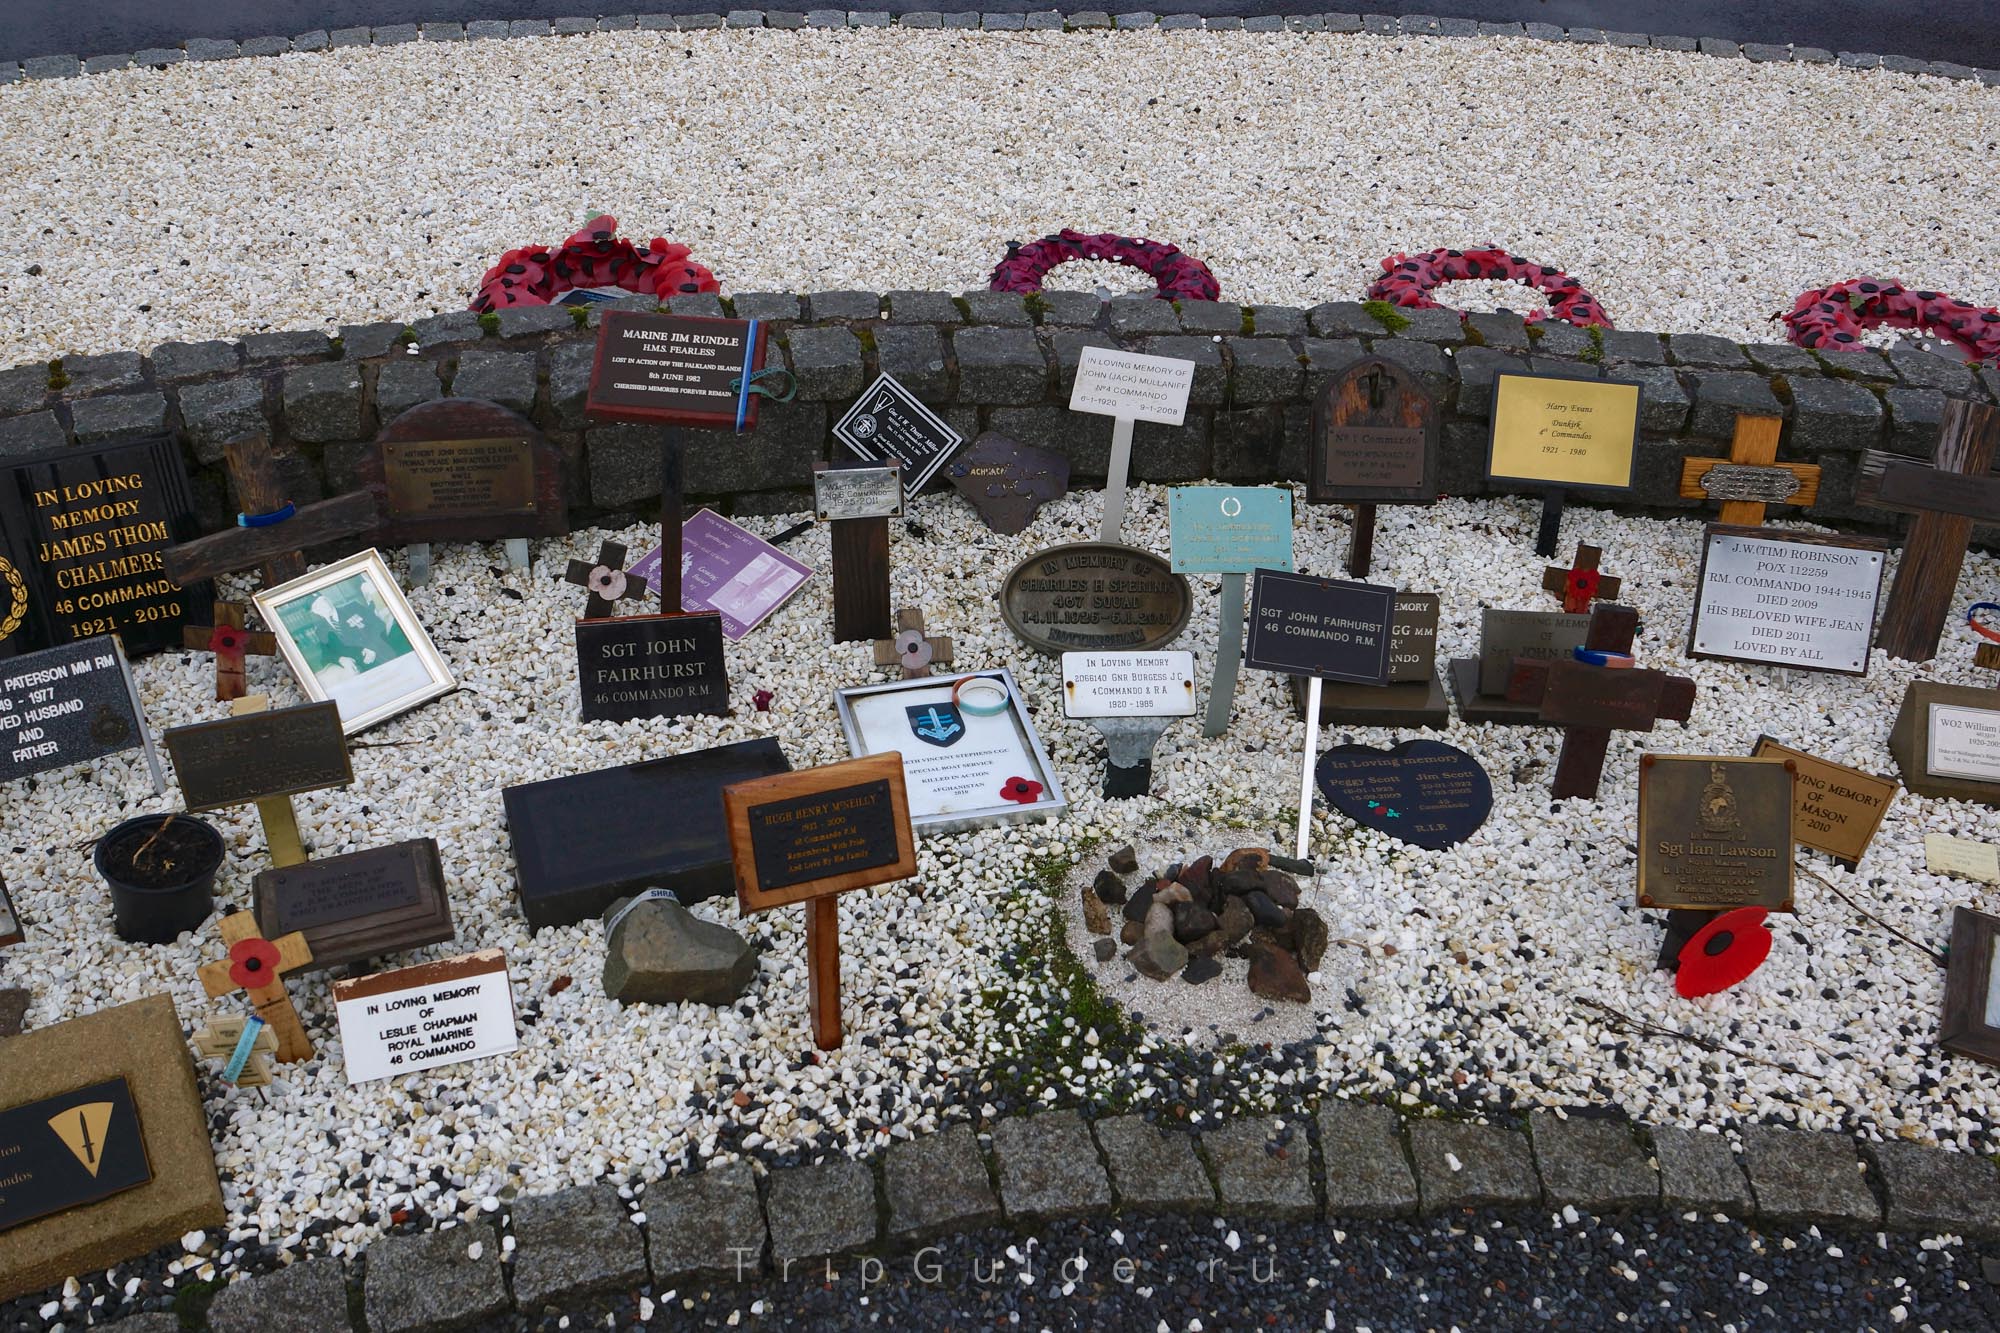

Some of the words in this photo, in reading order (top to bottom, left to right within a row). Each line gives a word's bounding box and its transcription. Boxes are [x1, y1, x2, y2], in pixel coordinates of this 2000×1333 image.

[623, 330, 668, 341] MARINE
[671, 333, 689, 342] JIM
[692, 334, 739, 347] RUNDLE
[670, 346, 715, 356] FEARLESS
[685, 362, 716, 370] FALKLAND
[1099, 359, 1131, 369] LOVING
[1133, 364, 1173, 375] MEMORY
[662, 373, 684, 381] JUNE
[686, 374, 700, 382] 1982
[1083, 370, 1106, 379] JOHN
[1108, 373, 1137, 383] (JACK)
[1139, 377, 1187, 390] MULLANIFF
[1081, 396, 1116, 407] 6-1-1920
[1113, 387, 1167, 401] COMMANDO
[1545, 402, 1567, 413] Harry
[1571, 405, 1593, 413] Evans
[1552, 420, 1583, 430] Dunkirk
[1551, 430, 1592, 440] Commandos
[1542, 446, 1559, 454] 1921
[1569, 448, 1586, 456] 1980
[34, 490, 59, 507] IN
[63, 474, 143, 502] LOVING
[51, 500, 140, 530] MEMORY
[40, 533, 106, 562] JAMES
[109, 521, 168, 548] THOM
[1790, 549, 1859, 566] ROBINSON
[57, 551, 164, 589] CHALMERS
[1042, 560, 1059, 576] IN
[1065, 554, 1128, 570] MEMORY
[1133, 563, 1152, 578] OF
[1757, 561, 1786, 573] PO/X
[1790, 565, 1828, 578] 112259
[1018, 579, 1088, 593] CHARLES
[1094, 579, 1104, 592] H
[1709, 572, 1731, 584] RM.
[1735, 575, 1811, 593] COMMANDO
[1815, 585, 1872, 600] 1944-1945
[56, 600, 74, 615] 46
[1394, 603, 1429, 612] EMORY
[1756, 593, 1788, 606] DIED
[1791, 599, 1818, 610] 2009
[71, 617, 118, 638] 1921
[135, 603, 181, 623] 2010
[1261, 607, 1283, 618] SGT
[1288, 611, 1318, 623] JOHN
[1323, 616, 1383, 633] FAIRHURST
[1706, 604, 1728, 615] HIS
[1731, 606, 1790, 623] BELOVED
[1794, 615, 1827, 627] WIFE
[1829, 619, 1864, 632] JEAN
[1264, 623, 1279, 632] 46
[1284, 625, 1349, 642] COMMANDO
[1355, 636, 1376, 647] R.M.
[1414, 628, 1432, 636] MM
[1752, 626, 1783, 639] DIED
[1786, 631, 1811, 642] 2011
[601, 643, 637, 659] SGT
[645, 638, 696, 656] JOHN
[1733, 640, 1777, 654] LOVED
[1780, 645, 1797, 656] BY
[1800, 649, 1824, 660] ALL
[1101, 659, 1132, 667] LOVING
[1136, 658, 1169, 666] MEMORY
[5, 665, 68, 691] PATERSON
[71, 660, 92, 675] MM
[95, 654, 115, 669] RM
[597, 662, 706, 684] FAIRHURST
[1132, 673, 1167, 681] BURGESS
[29, 688, 54, 705] 1977
[594, 694, 609, 704] 46
[612, 687, 684, 702] COMMANDO
[688, 684, 712, 696] R.M.
[25, 699, 84, 723] HUSBAND
[1941, 719, 1961, 728] WO2
[1965, 722, 1996, 733] William
[18, 727, 44, 744] AND
[12, 741, 58, 763] FATHER
[921, 754, 954, 763] VINCENT
[956, 750, 993, 759] STEPHENS
[909, 767, 942, 775] SPECIAL
[963, 760, 994, 768] SERVICE
[1332, 761, 1347, 769] In
[1350, 757, 1400, 768] Loving
[1403, 755, 1458, 765] memory
[922, 776, 950, 784] KILLED
[962, 771, 990, 779] ACTION
[1329, 778, 1364, 787] Peggy
[1367, 775, 1401, 784] Scott
[1415, 773, 1439, 781] Jim
[932, 783, 985, 793] AFGHANISTAN
[1828, 783, 1880, 807] MEMORY
[1807, 791, 1825, 803] OF
[765, 813, 792, 825] HUGH
[795, 804, 829, 820] HENRY
[1801, 802, 1848, 825] MASON
[1413, 823, 1448, 833] R.I.P.
[1807, 819, 1831, 832] 2010
[832, 841, 847, 850] With
[1659, 842, 1684, 857] Sgt
[1689, 843, 1713, 854] Ian
[1720, 844, 1777, 858] Lawson
[367, 1005, 379, 1016] IN
[386, 995, 427, 1012] LOVING
[433, 985, 481, 1002] MEMORY
[419, 1007, 435, 1019] OF
[379, 1025, 417, 1041] LESLIE
[423, 1012, 478, 1031] CHAPMAN
[387, 1037, 425, 1052] ROYAL
[430, 1026, 474, 1043] MARINE
[389, 1055, 404, 1065] 46
[409, 1040, 476, 1061] COMMANDO
